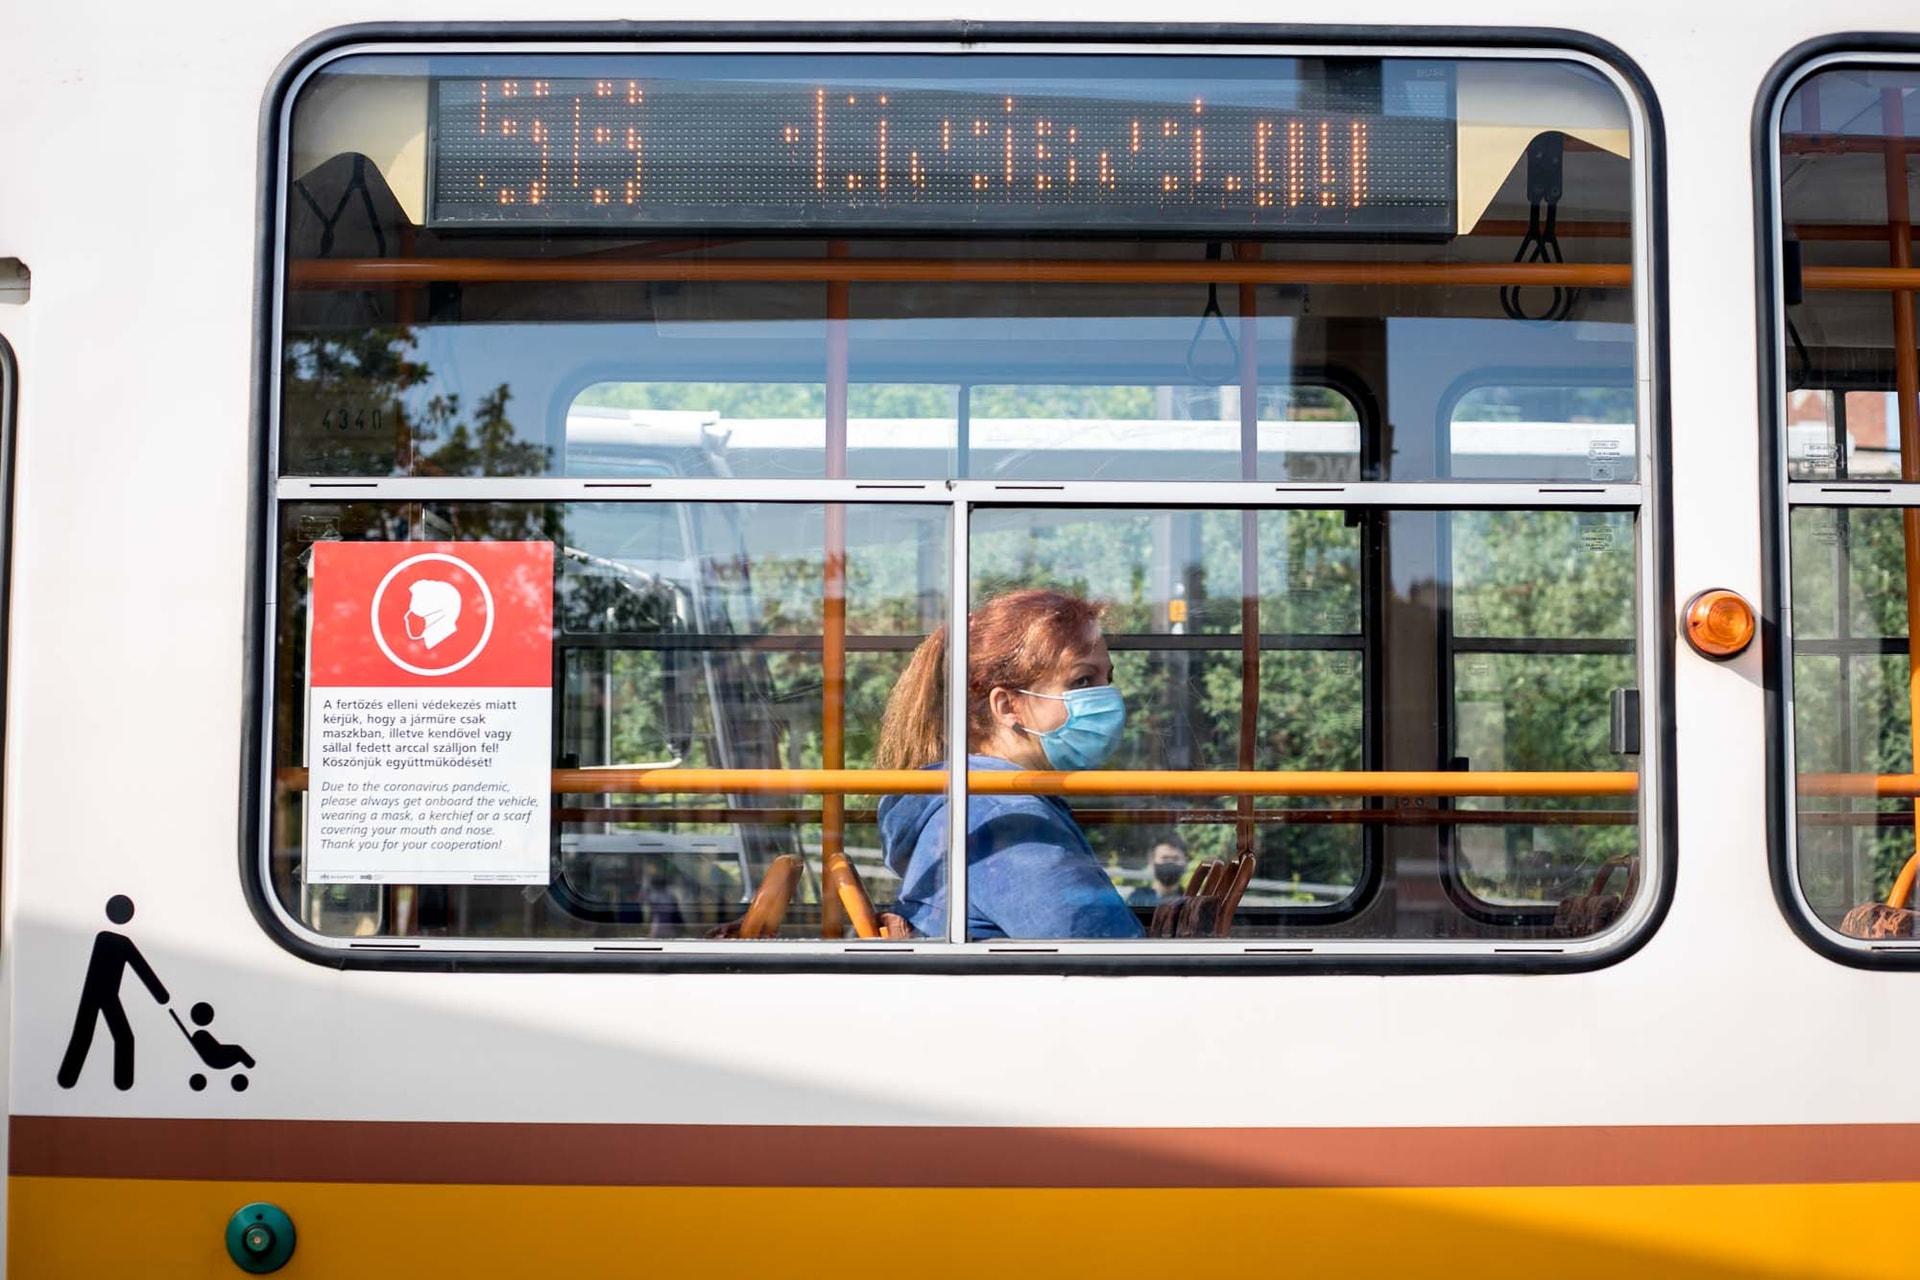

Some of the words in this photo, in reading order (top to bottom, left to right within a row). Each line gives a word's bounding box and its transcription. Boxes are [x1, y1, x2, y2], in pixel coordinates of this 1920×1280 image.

[321, 407, 383, 431] 4340
[323, 700, 332, 709] A
[337, 699, 383, 709] fertőzés
[387, 700, 417, 709] elleni
[422, 700, 481, 709] védekezés
[486, 700, 516, 709] miatt
[323, 714, 362, 726] kérjük,
[368, 714, 395, 726] hogy
[410, 714, 456, 726] járműre
[460, 714, 485, 724] csak
[323, 728, 384, 739] maszkban,
[390, 728, 424, 738] illetve
[428, 728, 480, 738] kendővel
[485, 731, 511, 741] vagy
[323, 742, 351, 752] sállal
[356, 742, 391, 752] fedett
[395, 743, 429, 752] arccal
[433, 743, 476, 755] szálljon
[481, 743, 498, 752] fel!
[323, 757, 381, 769] Köszönjük
[386, 757, 492, 769] együttműködését!
[322, 782, 344, 791] Due
[348, 783, 358, 791] to
[363, 783, 380, 791] the
[452, 782, 509, 793] pandemic,
[321, 796, 356, 807] please
[361, 797, 399, 808] always
[404, 798, 421, 808] get
[425, 797, 473, 806] onboard
[477, 797, 495, 806] the
[499, 796, 538, 807] vehicle,
[322, 813, 366, 823] wearing
[382, 810, 414, 820] mask,
[430, 811, 474, 823] kerchief
[504, 810, 532, 823] scarf
[321, 827, 368, 837] covering
[371, 827, 396, 837] your
[401, 825, 436, 834] mouth
[441, 825, 462, 834] and
[322, 839, 354, 848] Thank
[358, 842, 378, 851] you
[381, 839, 398, 851] for
[402, 842, 427, 851] your
[431, 840, 502, 851] cooperation!
